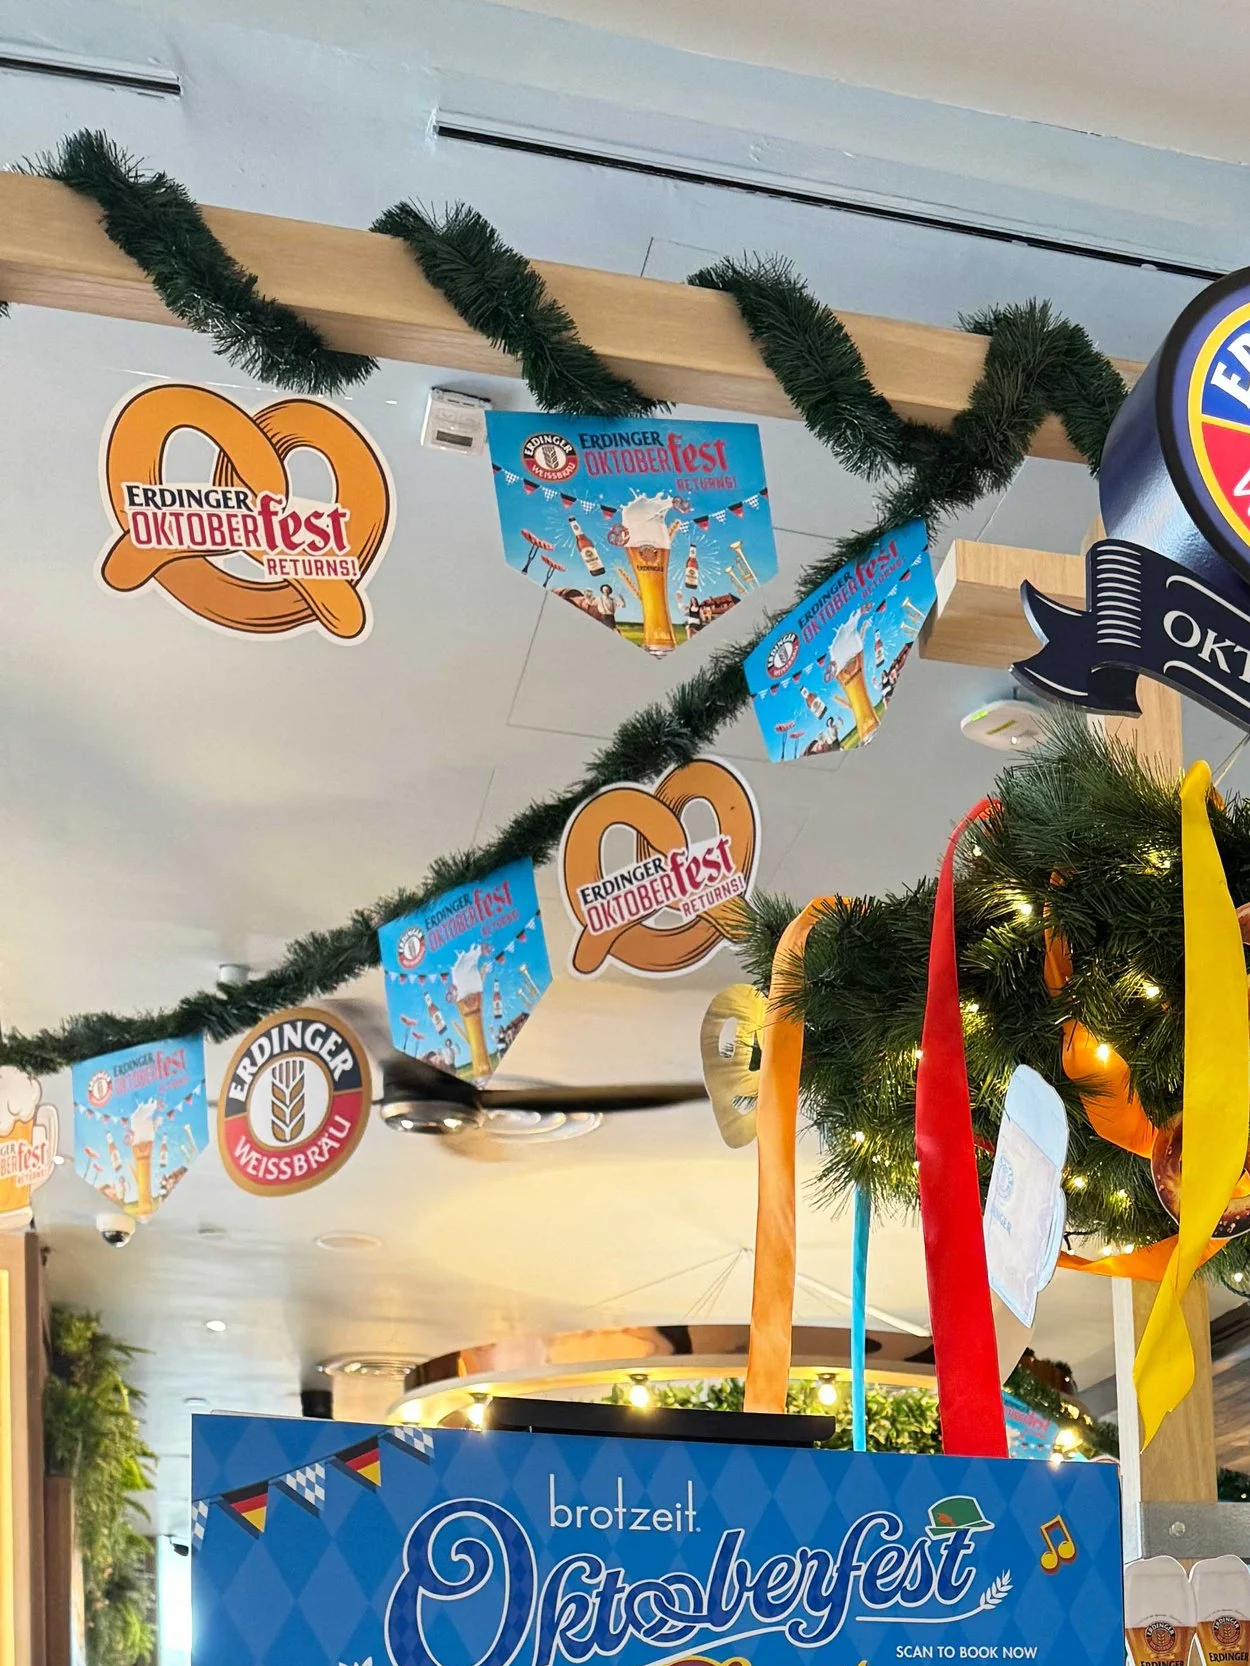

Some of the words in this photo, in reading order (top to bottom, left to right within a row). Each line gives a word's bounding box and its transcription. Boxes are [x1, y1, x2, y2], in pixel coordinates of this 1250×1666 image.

[525, 435, 573, 456] ERDINGER
[578, 431, 664, 449] ERDINGER
[126, 486, 254, 512] ERDINGER
[267, 558, 358, 577] RETURNS!
[798, 571, 854, 629] ERDINGER
[580, 857, 668, 905] ERDINGER
[682, 876, 744, 917] RETURNS!
[425, 894, 473, 930] ERDINGER
[229, 1022, 354, 1102] ERDINGER
[232, 1115, 351, 1181] WEISSBRÄU
[896, 1645, 933, 1659] SCAN
[937, 1646, 956, 1659] TO
[960, 1646, 998, 1659] BOOK
[1002, 1646, 1038, 1659] NOW
[1208, 1652, 1249, 1662] ERDINGER
